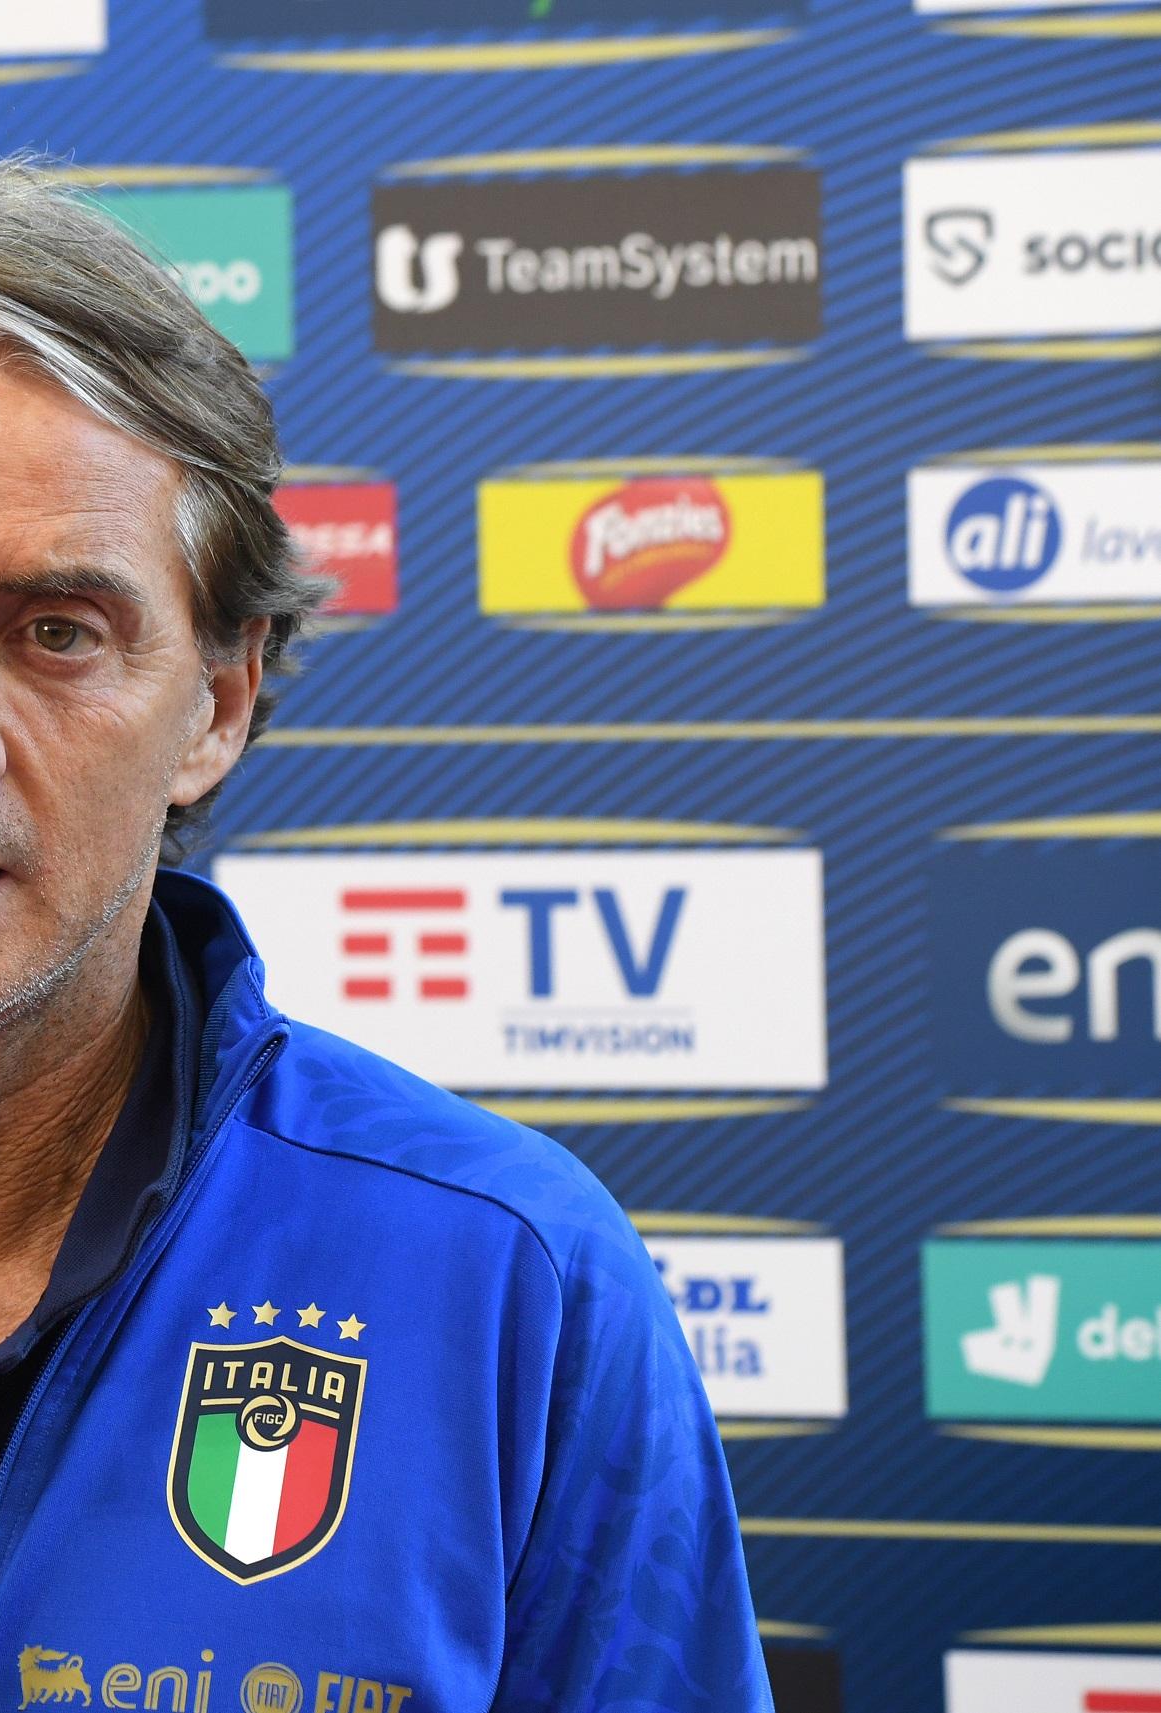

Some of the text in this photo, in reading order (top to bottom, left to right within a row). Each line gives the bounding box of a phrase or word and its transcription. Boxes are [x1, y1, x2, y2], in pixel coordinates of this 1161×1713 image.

[476, 232, 818, 300] TeamSystem
[951, 492, 1051, 570] ali
[500, 887, 687, 999] TV
[504, 1023, 696, 1056] TIMVISION
[203, 1361, 346, 1404] ITALIA
[254, 1412, 284, 1425] FIGC
[101, 1649, 214, 1713] eni
[257, 1671, 412, 1713] FIAT FIAT
